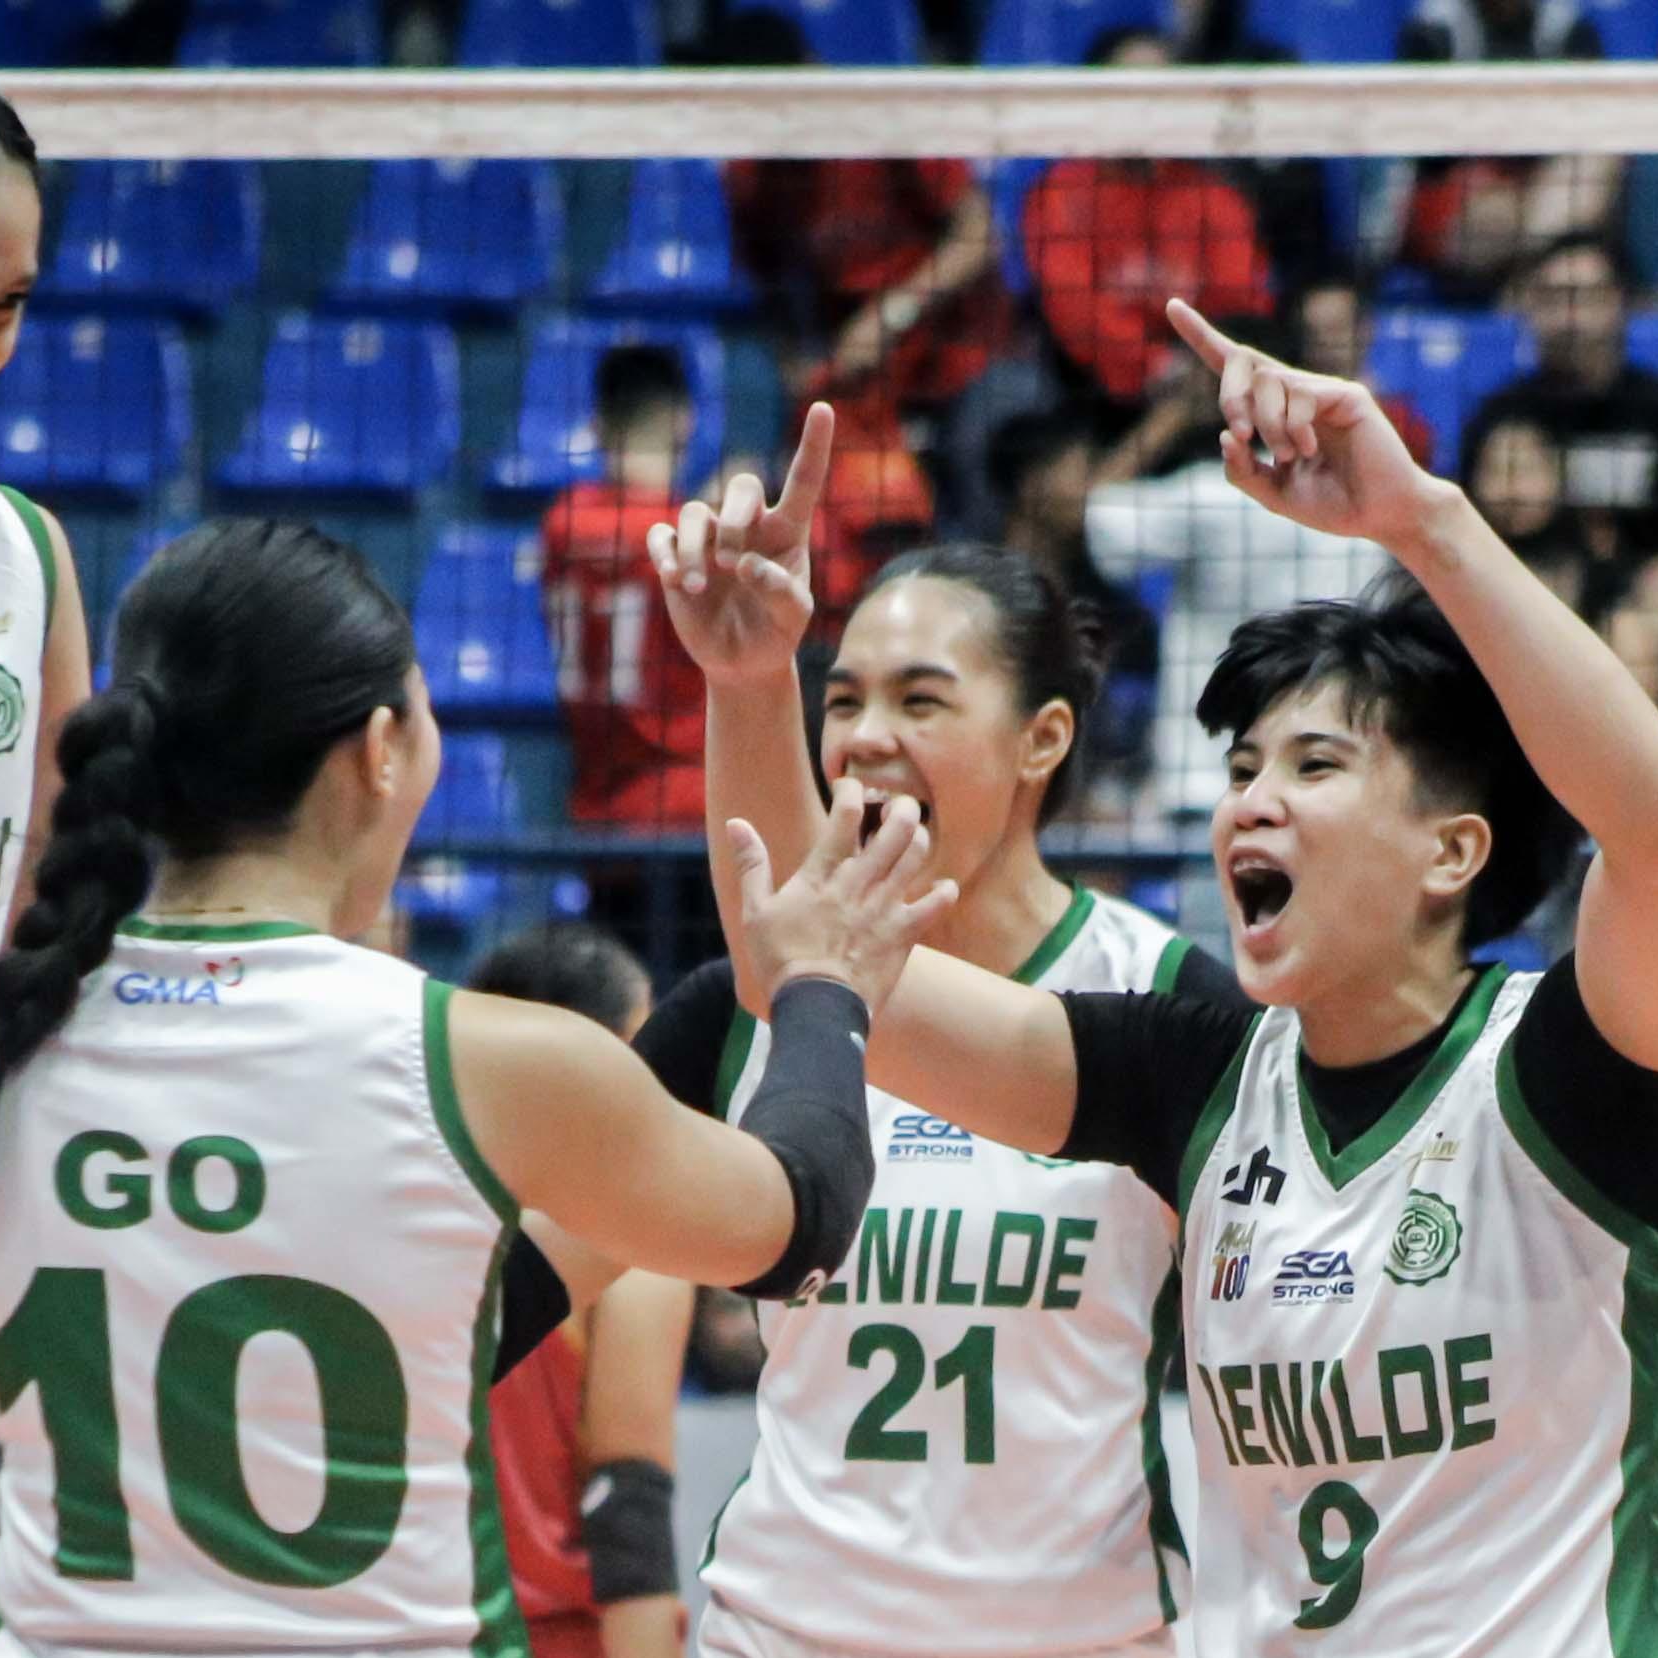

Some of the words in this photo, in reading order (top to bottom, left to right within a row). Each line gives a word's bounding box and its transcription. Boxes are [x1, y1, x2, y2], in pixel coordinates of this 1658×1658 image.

[114, 972, 219, 1005] GMA
[888, 1144, 973, 1158] STRONG
[53, 1130, 267, 1234] GO
[1209, 1254, 1251, 1302] 100
[1275, 1250, 1355, 1279] SGA
[1272, 1281, 1355, 1299] STRONG
[844, 1322, 996, 1464] 21
[1293, 1480, 1380, 1631] 9
